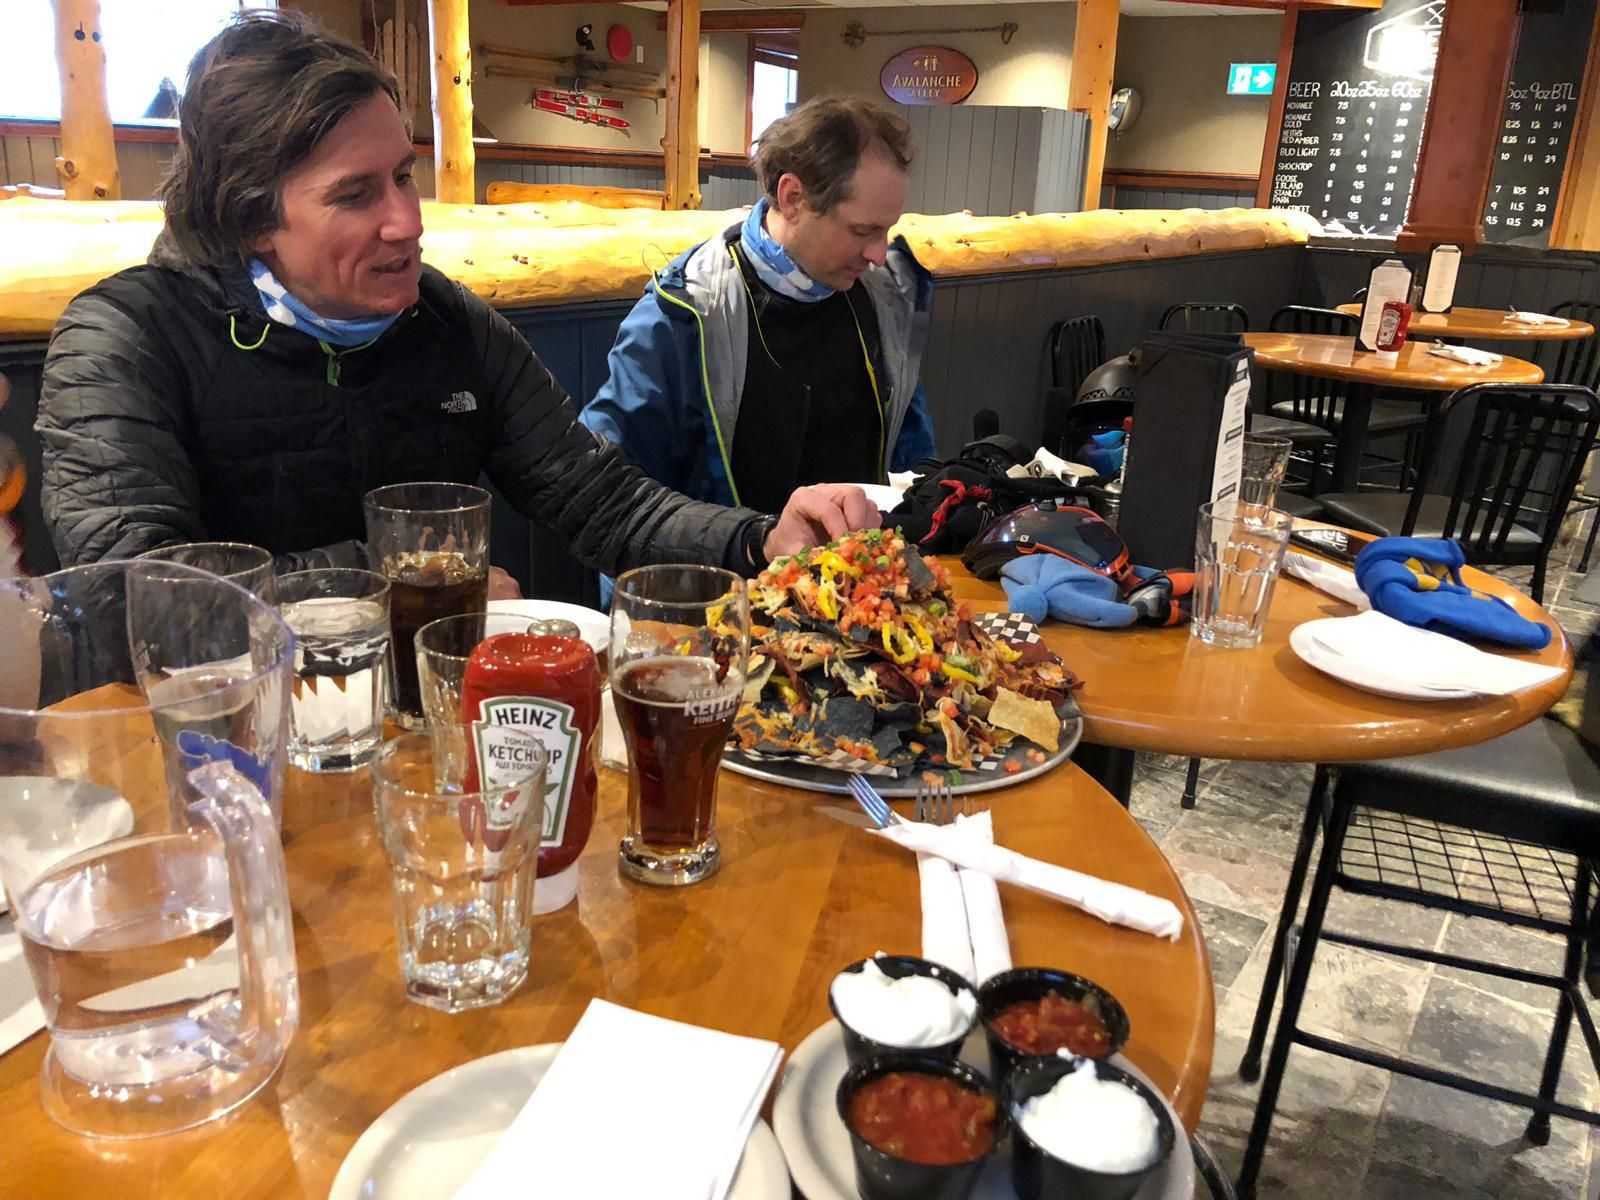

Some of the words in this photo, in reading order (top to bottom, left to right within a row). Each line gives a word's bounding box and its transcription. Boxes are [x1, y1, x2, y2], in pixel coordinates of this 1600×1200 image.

[892, 73, 961, 88] AVALANCHE
[911, 88, 941, 98] ALLEY
[1289, 81, 1320, 97] BEER
[1330, 80, 1359, 98] 20oz
[1358, 80, 1390, 98] 25oz
[1391, 80, 1423, 98] 60oz
[1529, 81, 1551, 99] 9oz
[1551, 82, 1577, 100] BTL
[1369, 101, 1376, 111] 9
[1534, 103, 1542, 112] 11
[1366, 116, 1374, 126] 9
[1281, 136, 1294, 144] RED
[1294, 136, 1319, 145] AMBER
[1363, 133, 1370, 142] 9
[1392, 133, 1406, 143] 20
[1527, 136, 1536, 145] 12
[1280, 147, 1296, 156] BUD
[1296, 147, 1320, 157] LIGHT
[1360, 149, 1368, 158] 9
[1501, 152, 1510, 161] 10
[1523, 153, 1534, 163] 14
[1329, 162, 1337, 172] 8
[1275, 174, 1298, 183] GOOSE
[1327, 179, 1334, 188] 8
[1274, 189, 1303, 197] STANLEY
[1495, 185, 1502, 193] 7
[1272, 195, 1290, 203] PARK
[1324, 193, 1331, 202] 8
[1490, 201, 1498, 210] 9
[1321, 209, 1328, 218] 8
[452, 391, 464, 401] THE
[441, 399, 465, 410] NORTH
[495, 707, 558, 730] HEINZ
[488, 744, 562, 765] KETCHUP
[511, 762, 553, 775] TOMAS
